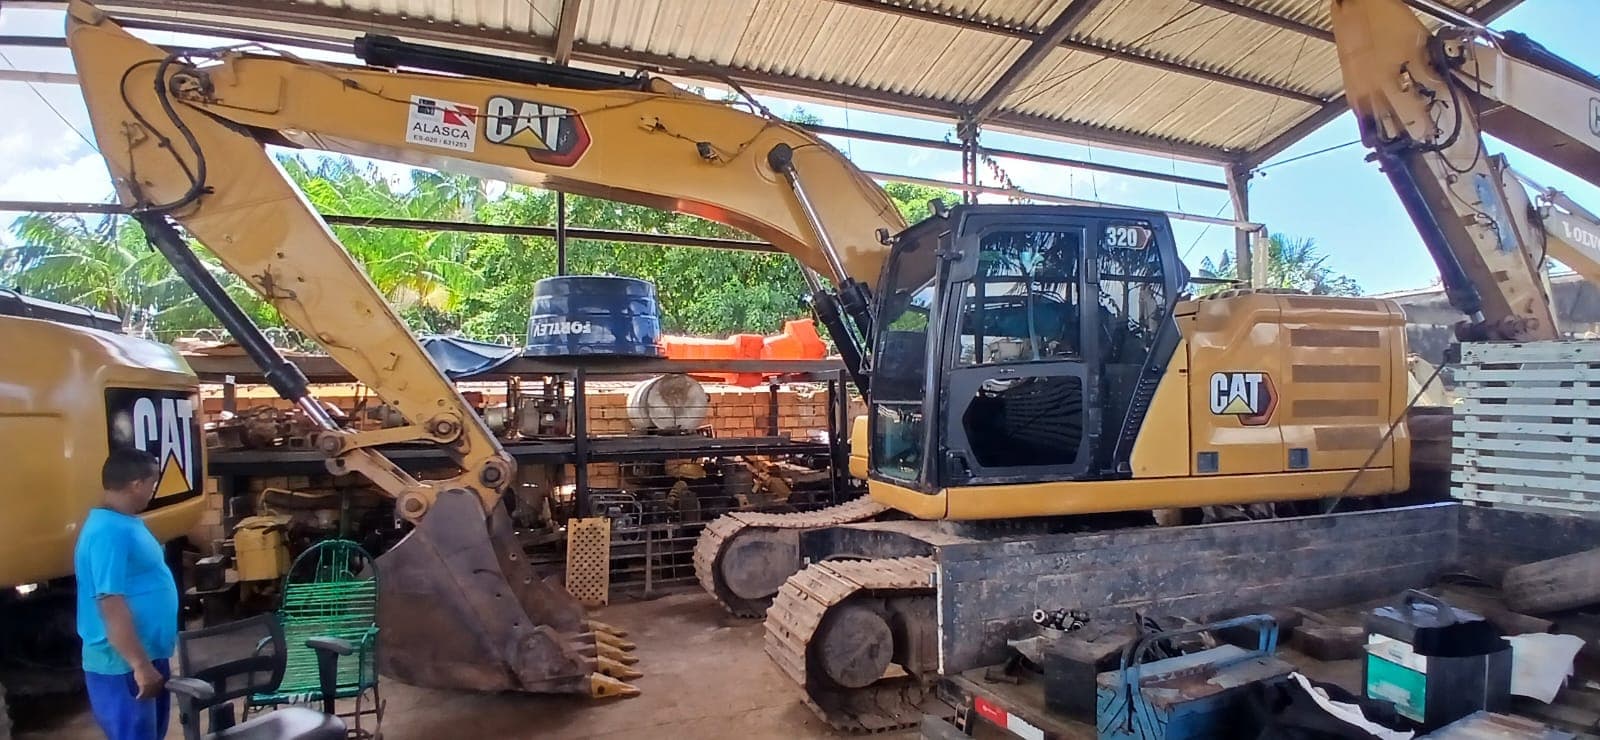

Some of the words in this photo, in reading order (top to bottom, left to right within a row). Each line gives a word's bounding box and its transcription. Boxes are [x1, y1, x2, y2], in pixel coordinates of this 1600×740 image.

[413, 122, 470, 140] ALASCA
[486, 97, 567, 151] CAT
[1107, 227, 1137, 247] 320
[1562, 220, 1600, 251] VOLV
[533, 320, 592, 338] FORTLEV
[1211, 372, 1262, 414] CAT
[133, 397, 194, 492] CAT
